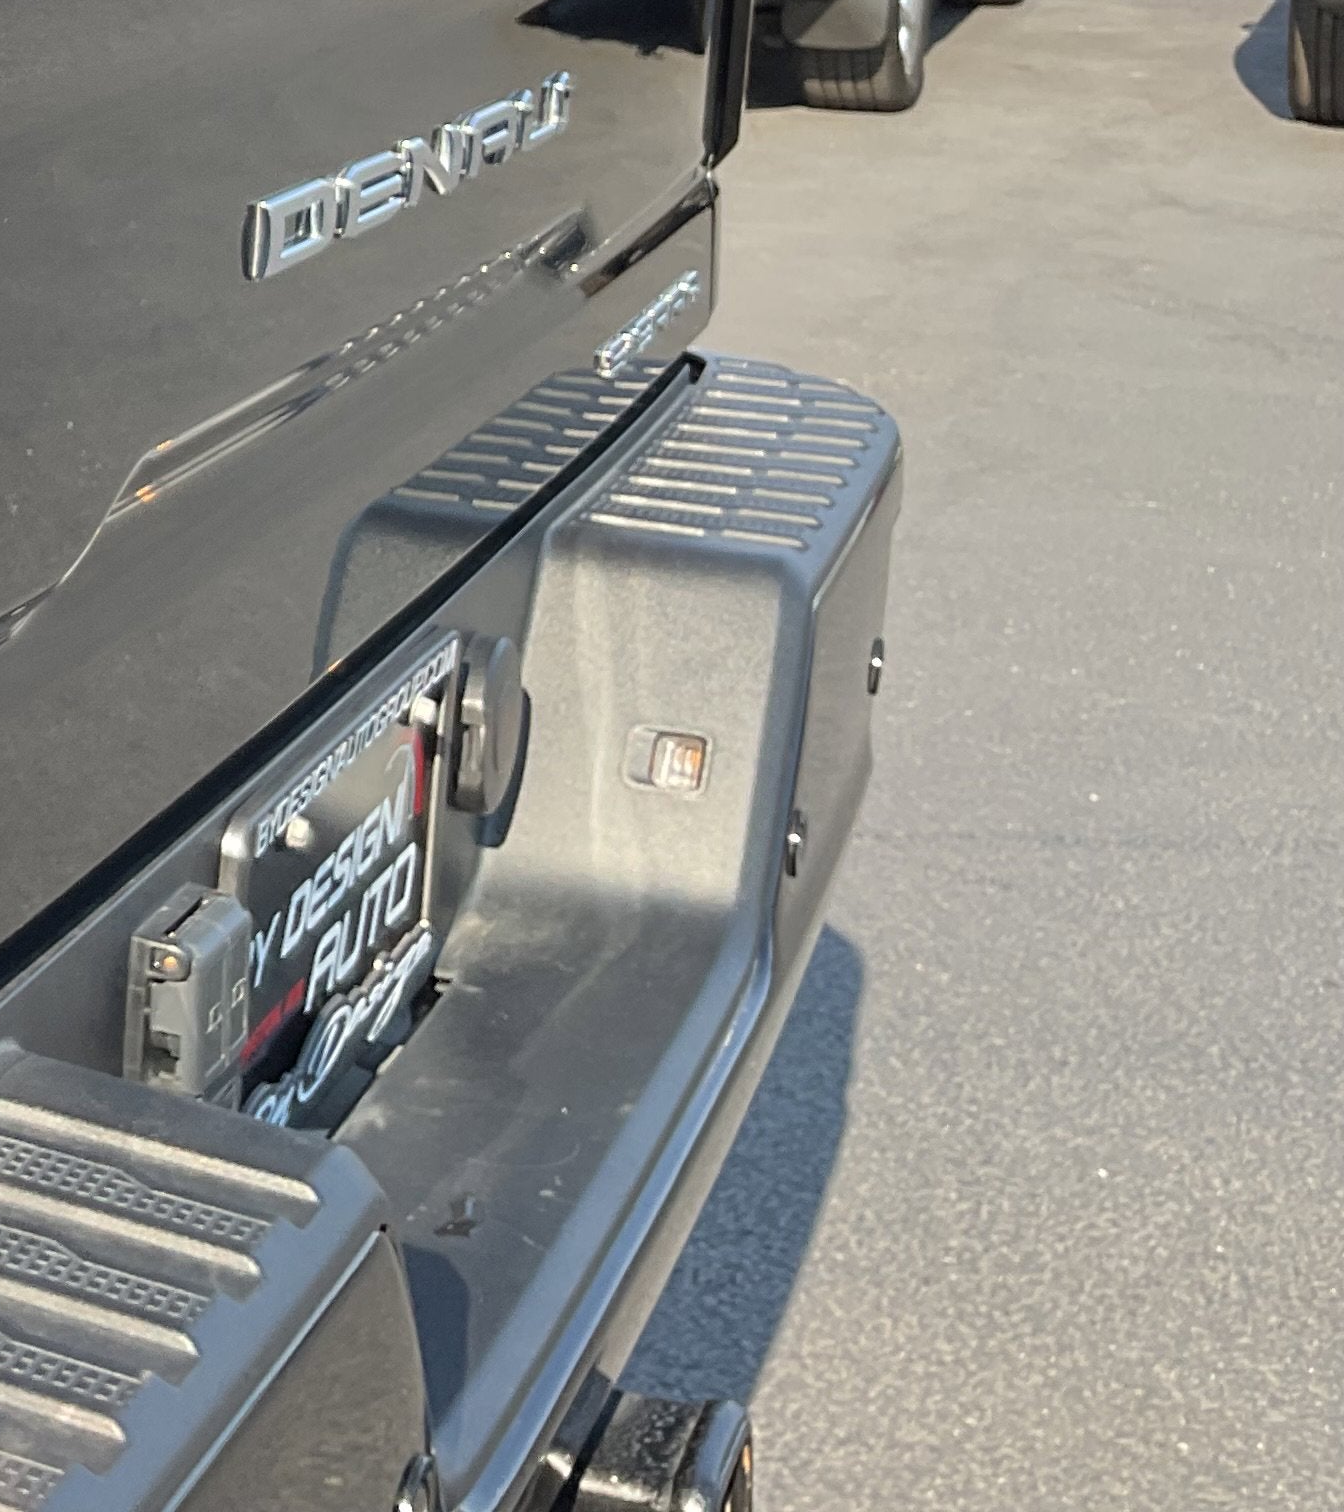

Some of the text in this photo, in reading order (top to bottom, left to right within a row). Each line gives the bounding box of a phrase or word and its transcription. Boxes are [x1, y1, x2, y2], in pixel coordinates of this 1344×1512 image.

[240, 70, 572, 283] DENALI
[248, 781, 406, 988] Y DESIGN
[303, 841, 417, 1015] AUTO
